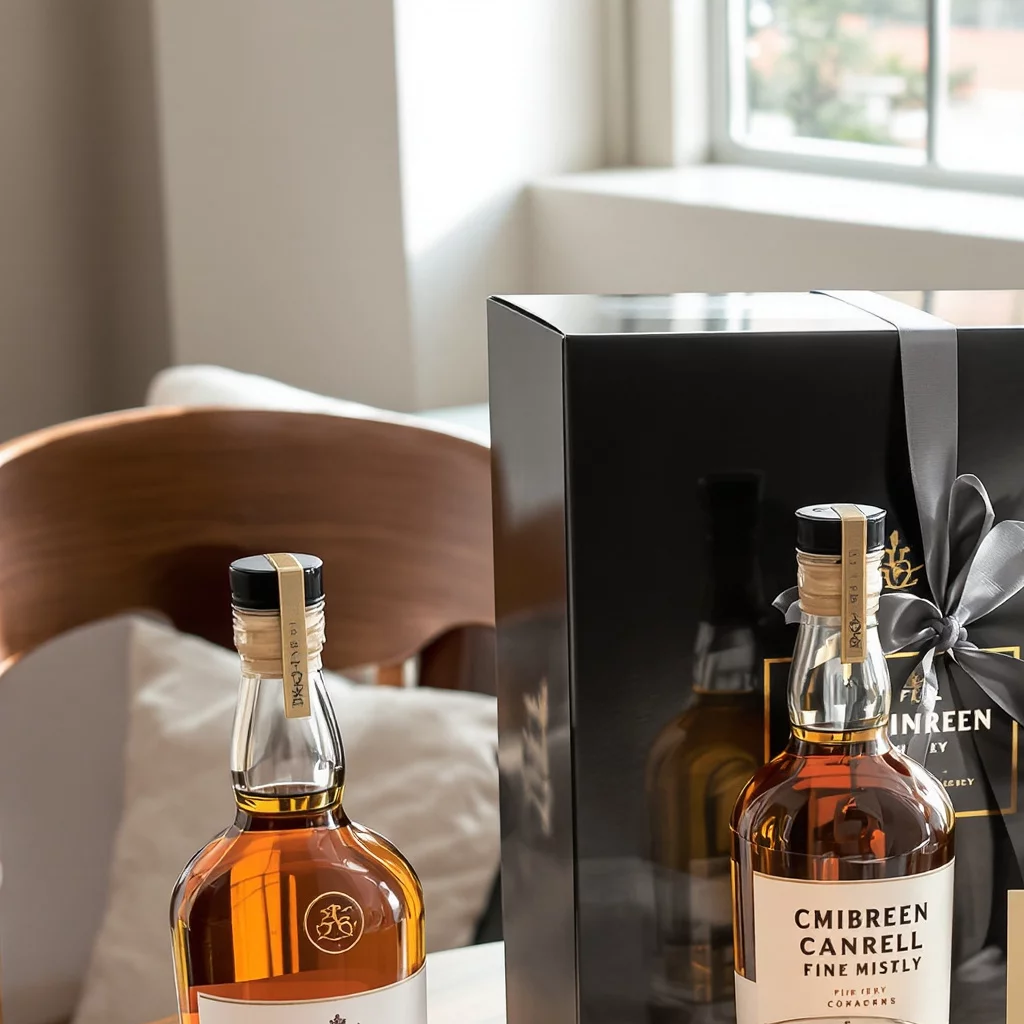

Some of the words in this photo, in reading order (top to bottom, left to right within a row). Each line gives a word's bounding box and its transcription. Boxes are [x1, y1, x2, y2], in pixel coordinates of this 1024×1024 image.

[794, 901, 928, 930] CMIBREEN
[799, 931, 923, 956] CANRELL
[803, 963, 848, 977] FINE
[856, 956, 922, 976] MISTLY
